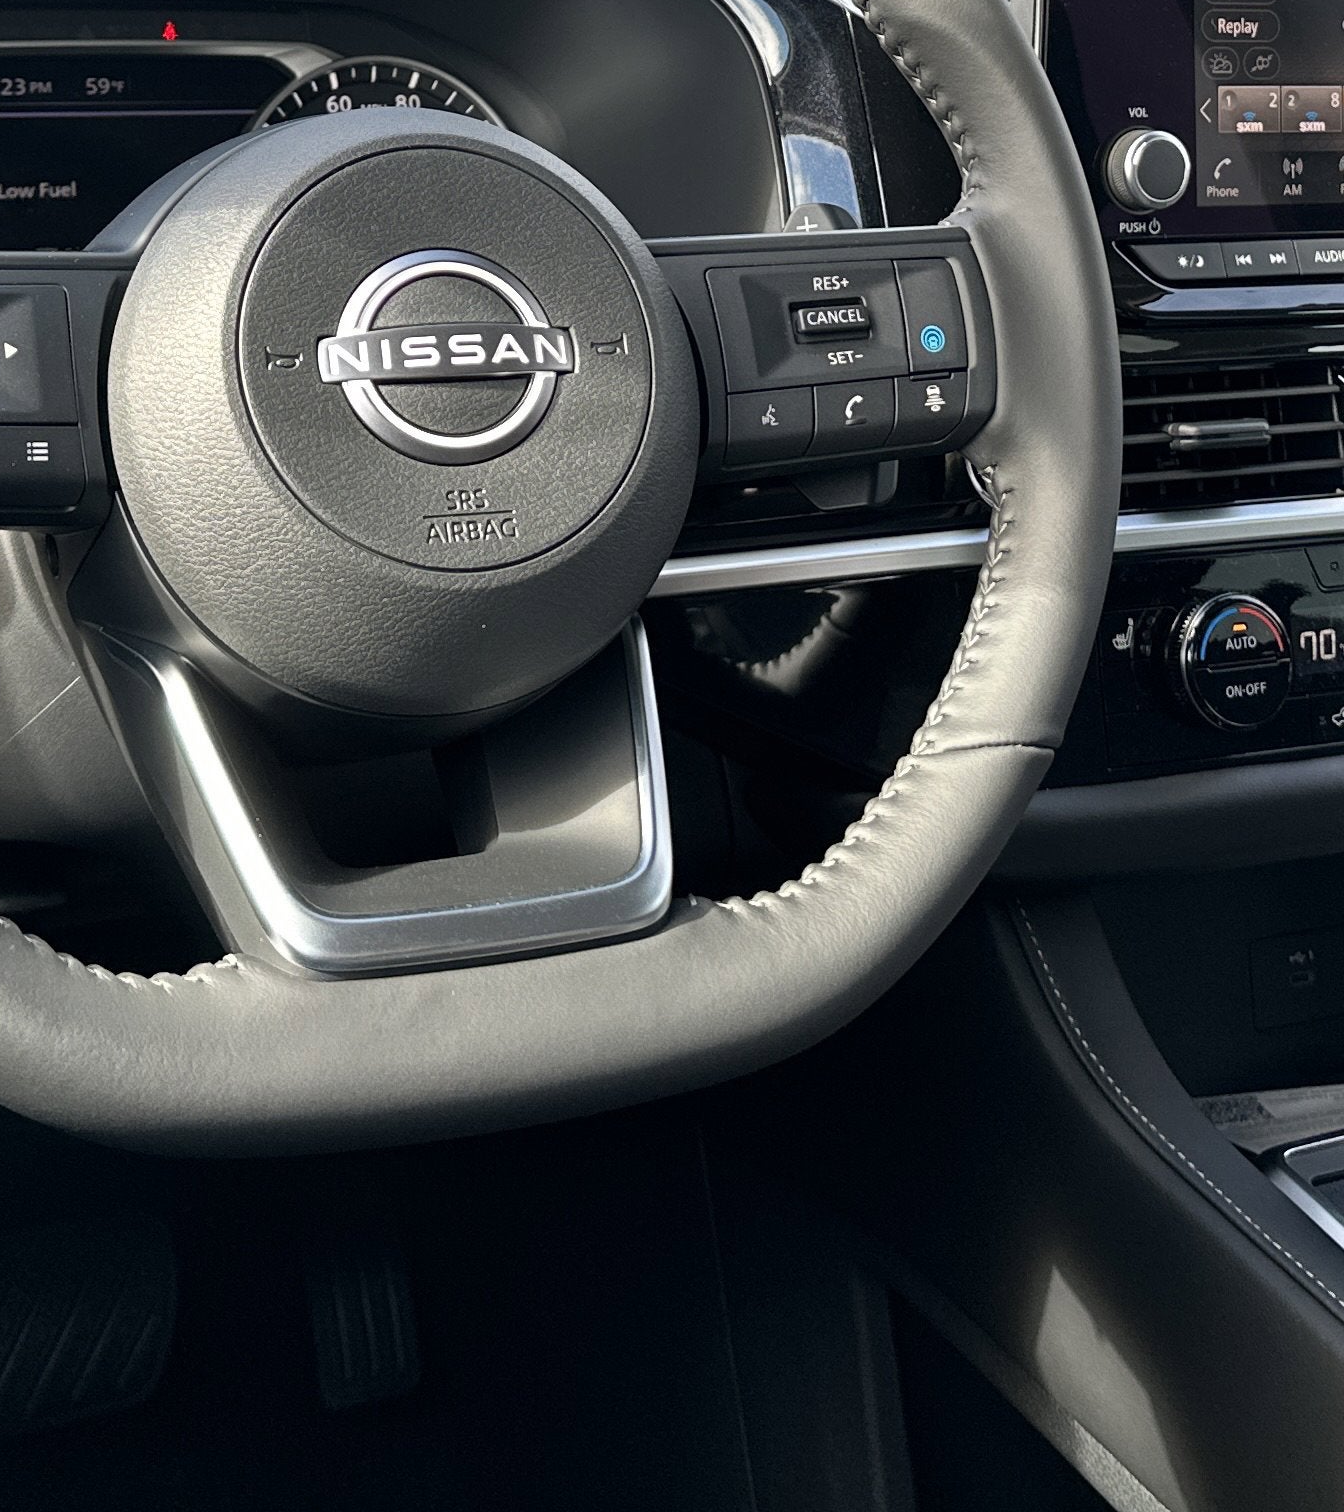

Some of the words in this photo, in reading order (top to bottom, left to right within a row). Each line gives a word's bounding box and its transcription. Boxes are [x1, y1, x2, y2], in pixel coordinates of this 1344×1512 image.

[1217, 17, 1259, 37] Replay
[29, 81, 52, 94] PM
[326, 94, 353, 114] 60
[394, 94, 421, 109] 80
[1226, 96, 1232, 107] 1
[1269, 93, 1278, 109] 2
[1288, 96, 1295, 107] 2
[1331, 92, 1340, 108] 8
[1128, 106, 1149, 119] VOL
[39, 180, 78, 198] Fuel
[1206, 186, 1240, 198] Phone
[1283, 184, 1303, 196] AM
[1119, 221, 1147, 234] PUSH
[812, 276, 849, 291] RES+
[806, 308, 865, 326] CANCEL
[329, 333, 567, 376] NISSAN
[445, 489, 489, 511] SRS
[425, 517, 519, 546] AIRBAG
[1225, 636, 1257, 651] AUTO
[1300, 628, 1337, 660] 70
